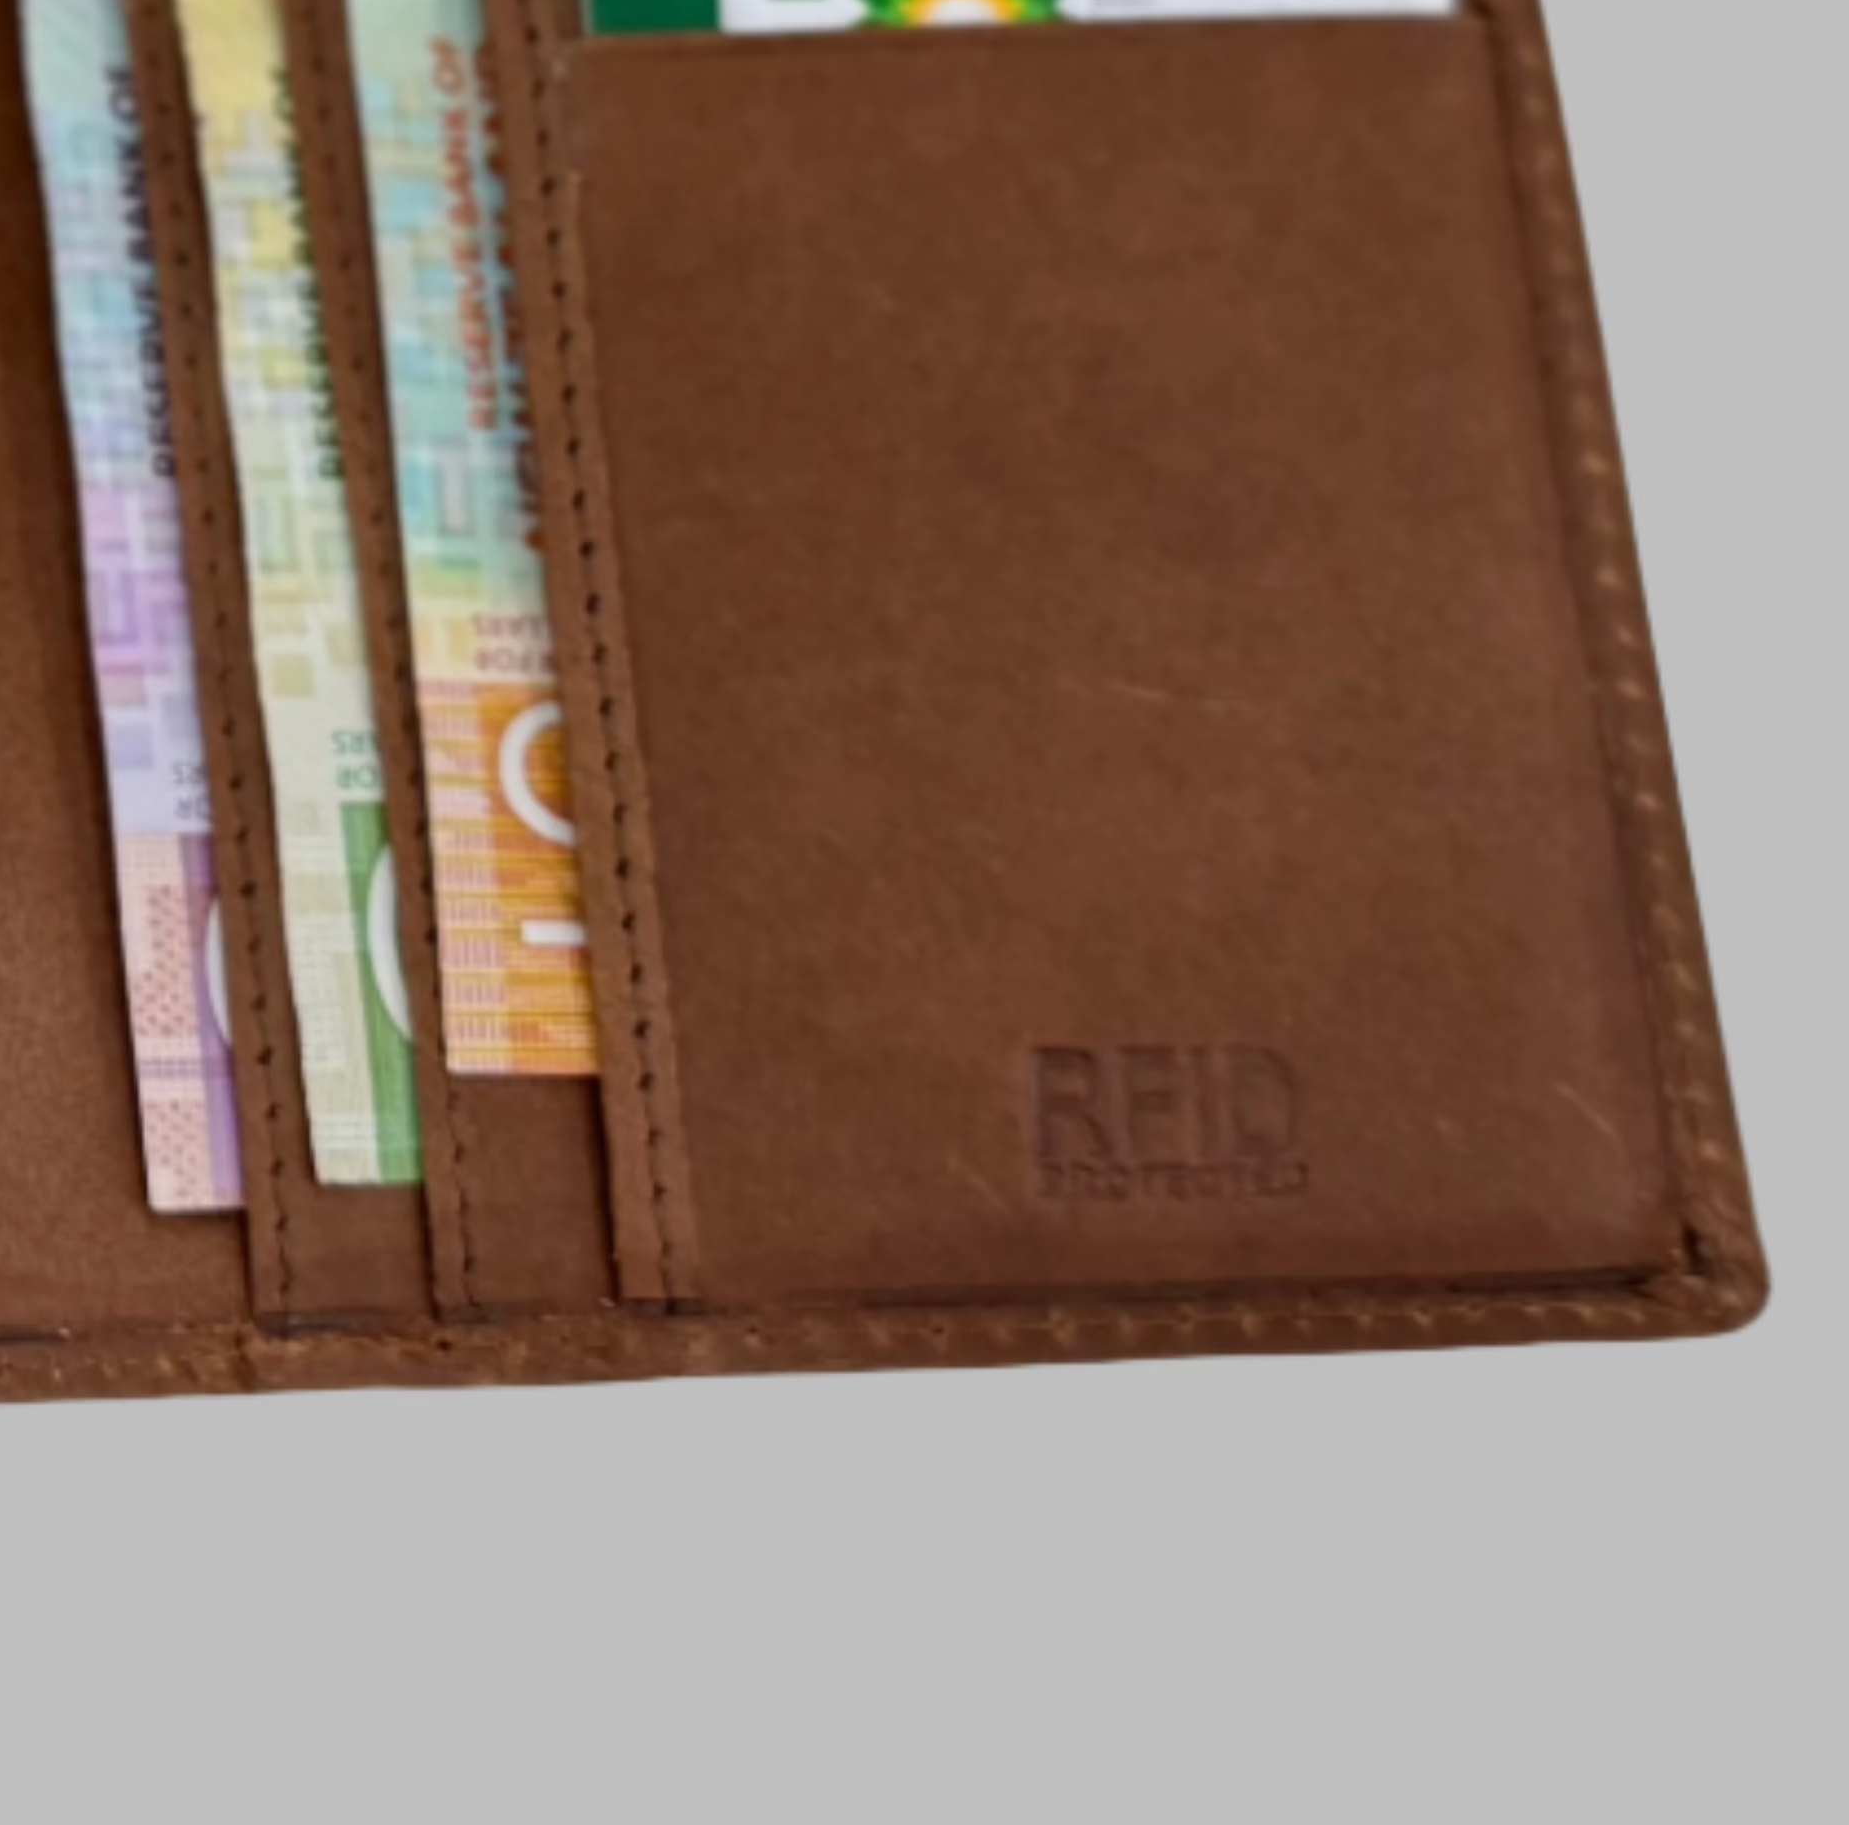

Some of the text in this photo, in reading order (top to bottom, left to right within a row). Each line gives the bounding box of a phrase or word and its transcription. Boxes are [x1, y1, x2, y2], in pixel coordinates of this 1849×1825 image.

[441, 108, 480, 227] BANK
[458, 241, 499, 431] RESERVE
[1033, 1045, 1303, 1160] RFID
